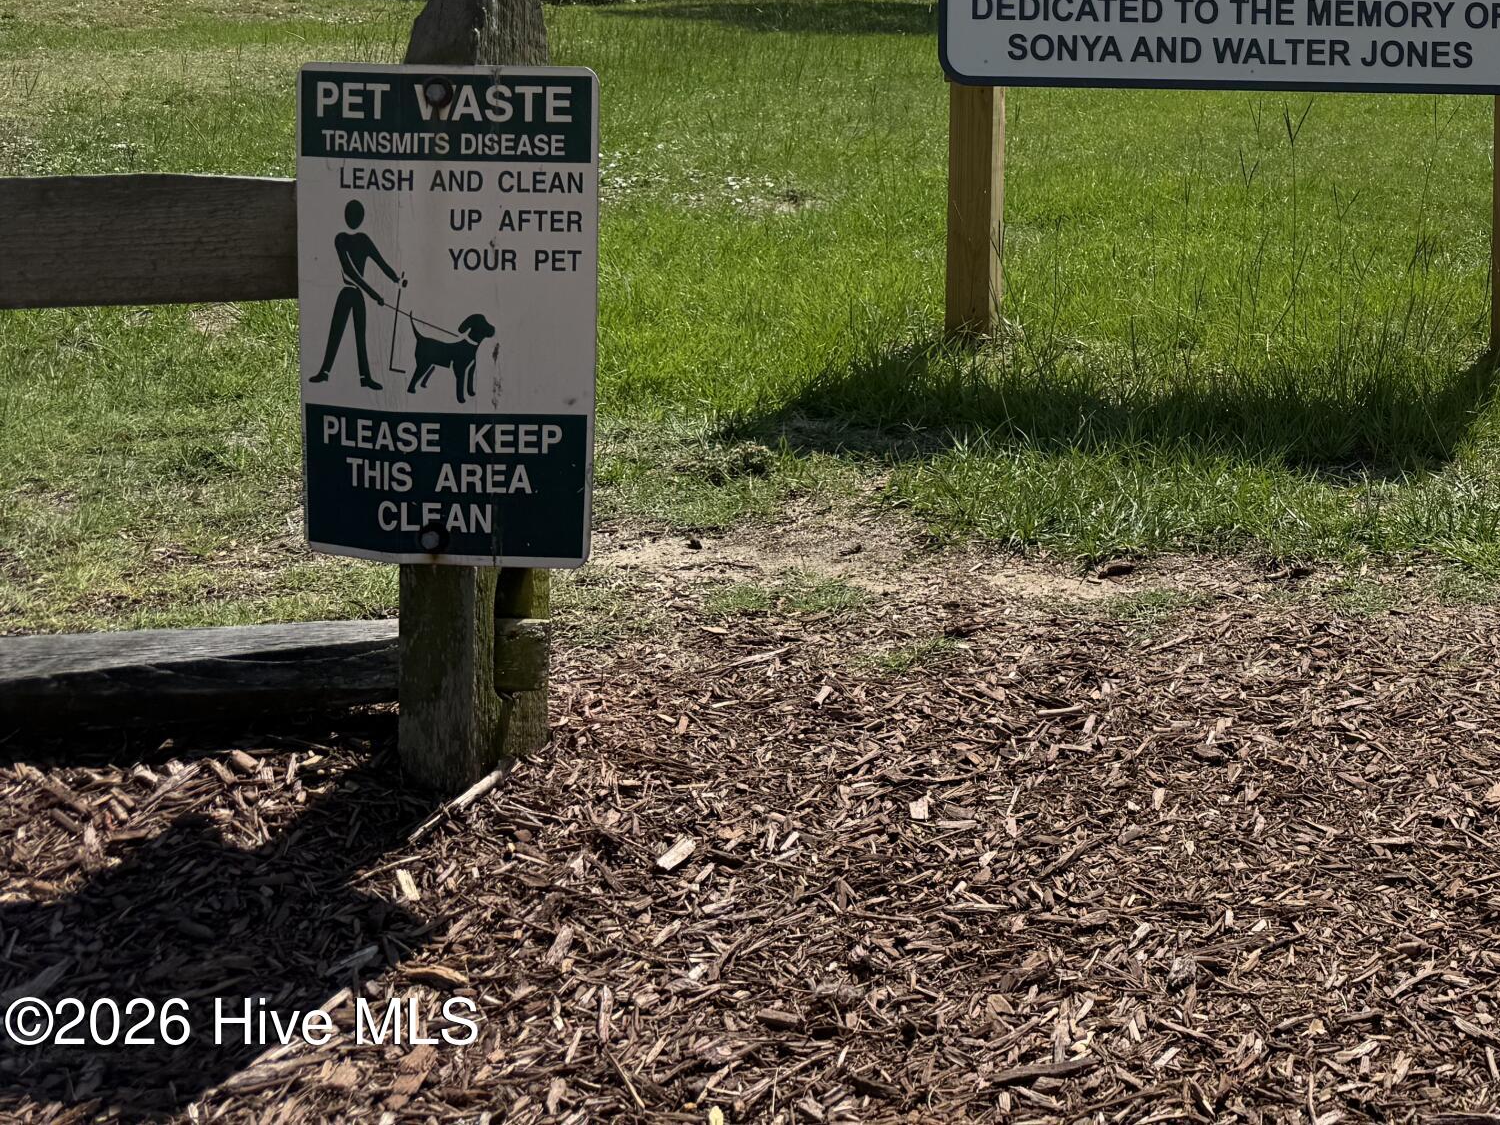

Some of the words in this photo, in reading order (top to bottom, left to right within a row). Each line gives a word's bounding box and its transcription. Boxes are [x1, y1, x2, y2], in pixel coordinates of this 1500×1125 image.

[1307, 0, 1453, 28] MEMORY
[1007, 33, 1123, 63] SONYA
[1130, 36, 1202, 64] AND
[1213, 38, 1350, 66] WALTER
[1360, 40, 1474, 69] JONES
[316, 81, 391, 120] PET
[321, 129, 450, 155] TRANSMITS
[460, 133, 566, 156] DISEASE
[339, 167, 414, 192] LEASH
[429, 169, 484, 193] AND
[497, 171, 584, 194] CLEAN
[450, 208, 482, 231] UP
[498, 209, 583, 233] AFTER
[448, 247, 517, 272] YOUR
[534, 249, 582, 272] PET
[322, 415, 441, 453] PLEASE
[469, 423, 563, 454] KEEP
[346, 457, 413, 492] THIS
[434, 462, 532, 494] AREA
[377, 500, 493, 534] CLEAN
